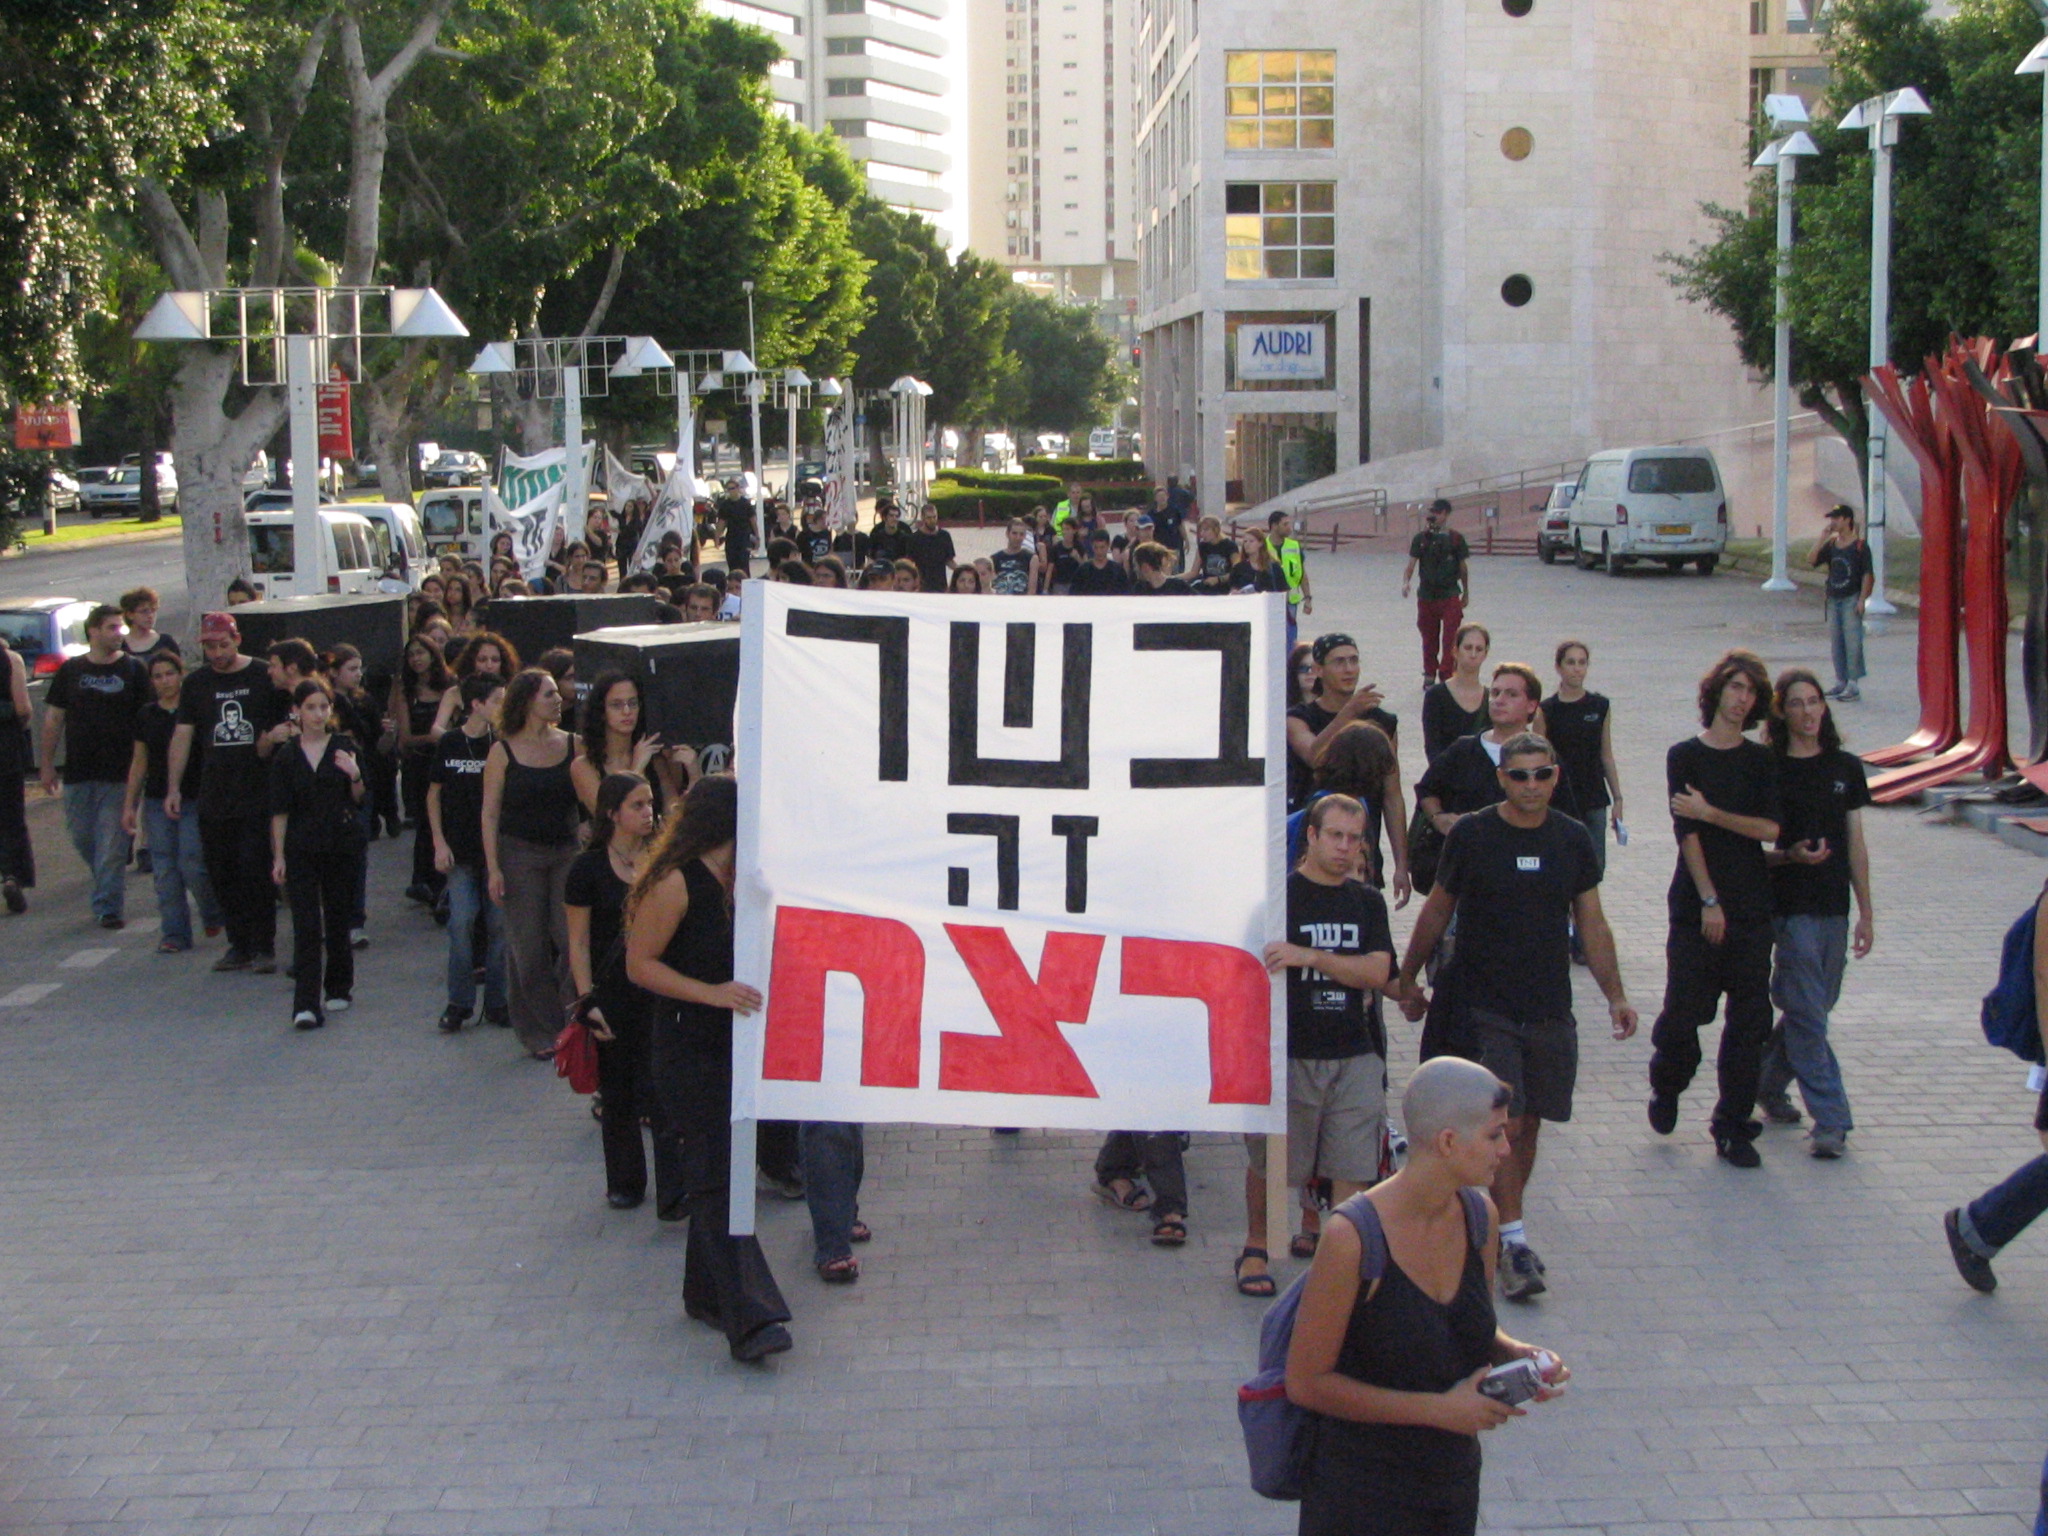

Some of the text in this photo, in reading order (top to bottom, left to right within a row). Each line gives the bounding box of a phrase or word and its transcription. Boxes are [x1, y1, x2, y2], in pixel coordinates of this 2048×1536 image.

[1252, 331, 1311, 355] AUDRI
[786, 608, 1265, 789] בשר
[947, 813, 1098, 913] זה
[1300, 923, 1359, 948] בשר
[762, 905, 1271, 1104] רצח
